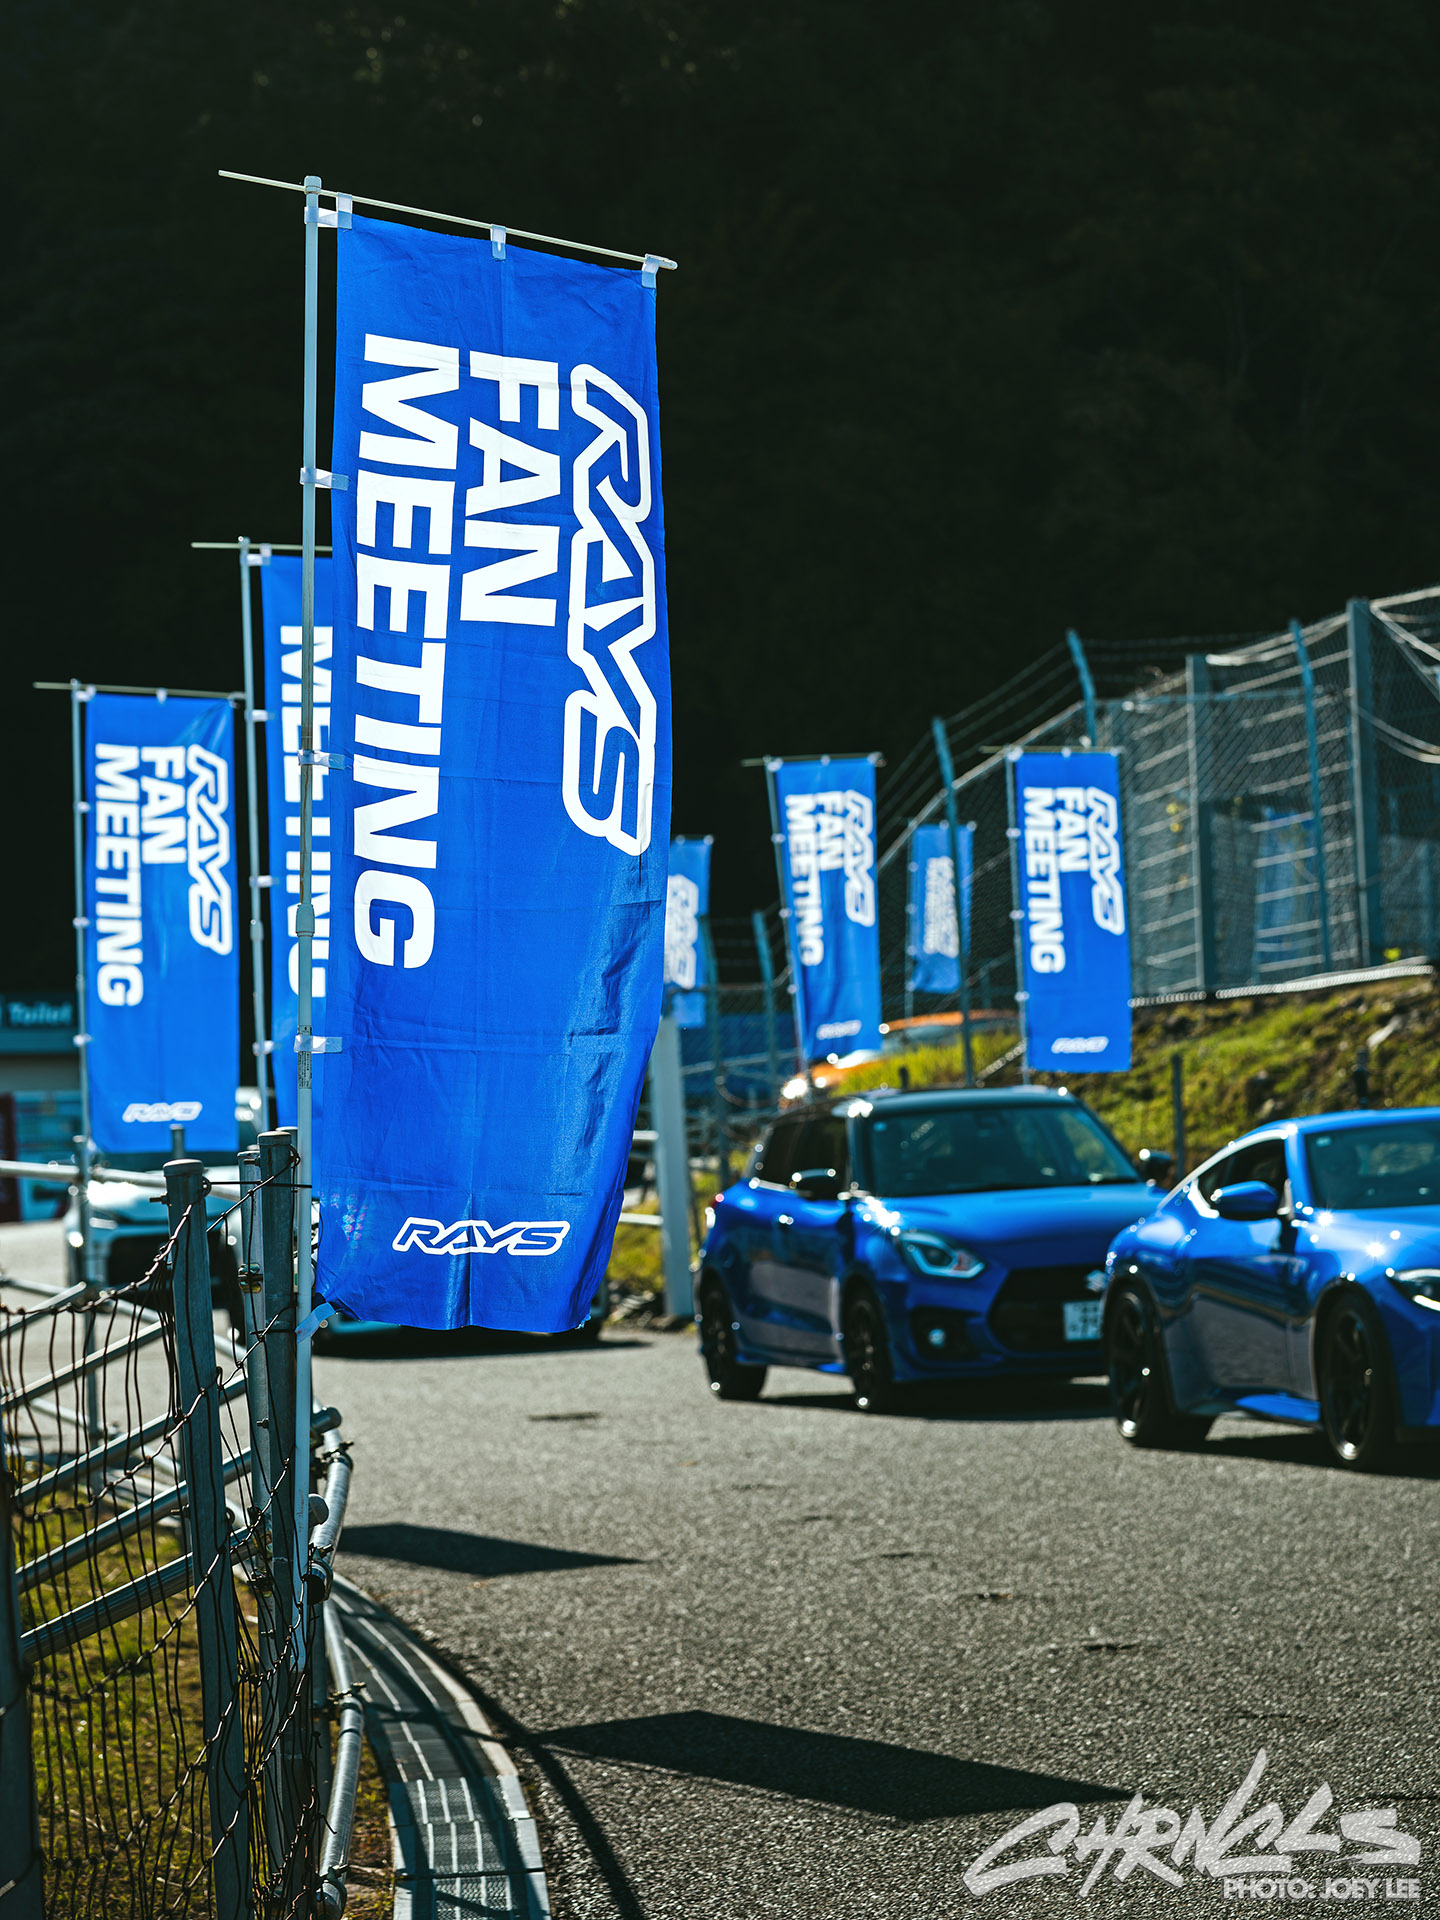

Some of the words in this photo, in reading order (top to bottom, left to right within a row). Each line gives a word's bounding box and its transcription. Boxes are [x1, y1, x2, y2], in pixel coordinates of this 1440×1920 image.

[460, 348, 560, 627] FAN
[353, 333, 460, 969] MEETING
[562, 364, 656, 856] RAYS
[95, 743, 144, 1006] MEETING
[140, 745, 187, 864] FAN
[186, 743, 233, 956] RAYS
[784, 793, 825, 967] MEETING
[815, 790, 844, 872] FAN
[1023, 786, 1066, 973] MEETING
[1054, 787, 1090, 873] FAN
[392, 1216, 571, 1256] RAYS
